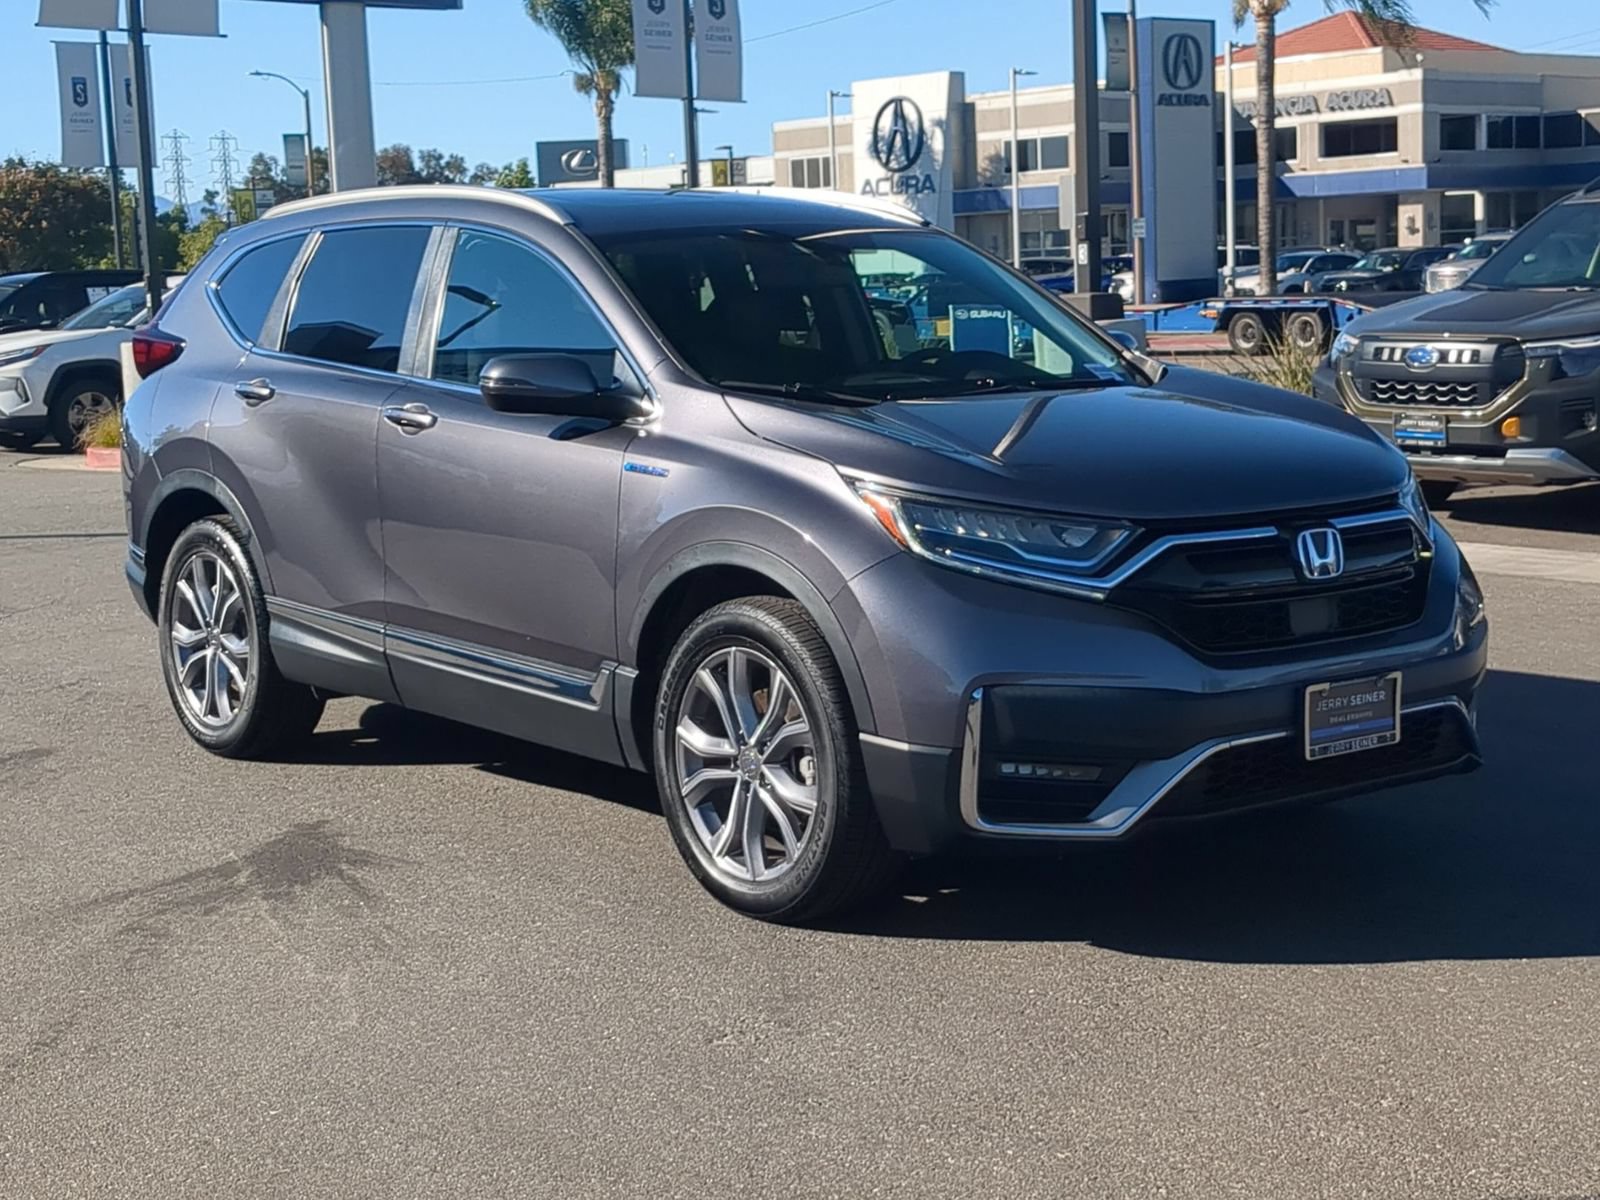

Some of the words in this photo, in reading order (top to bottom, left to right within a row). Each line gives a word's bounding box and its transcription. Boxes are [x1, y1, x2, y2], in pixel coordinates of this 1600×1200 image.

[1156, 93, 1211, 107] ACURA
[1234, 94, 1321, 118] VANCIA
[1326, 88, 1394, 112] ACURA
[861, 174, 936, 197] ACURA
[969, 309, 1007, 319] SUBARU
[1316, 696, 1349, 711] JERRY
[1350, 690, 1386, 706] SEINER
